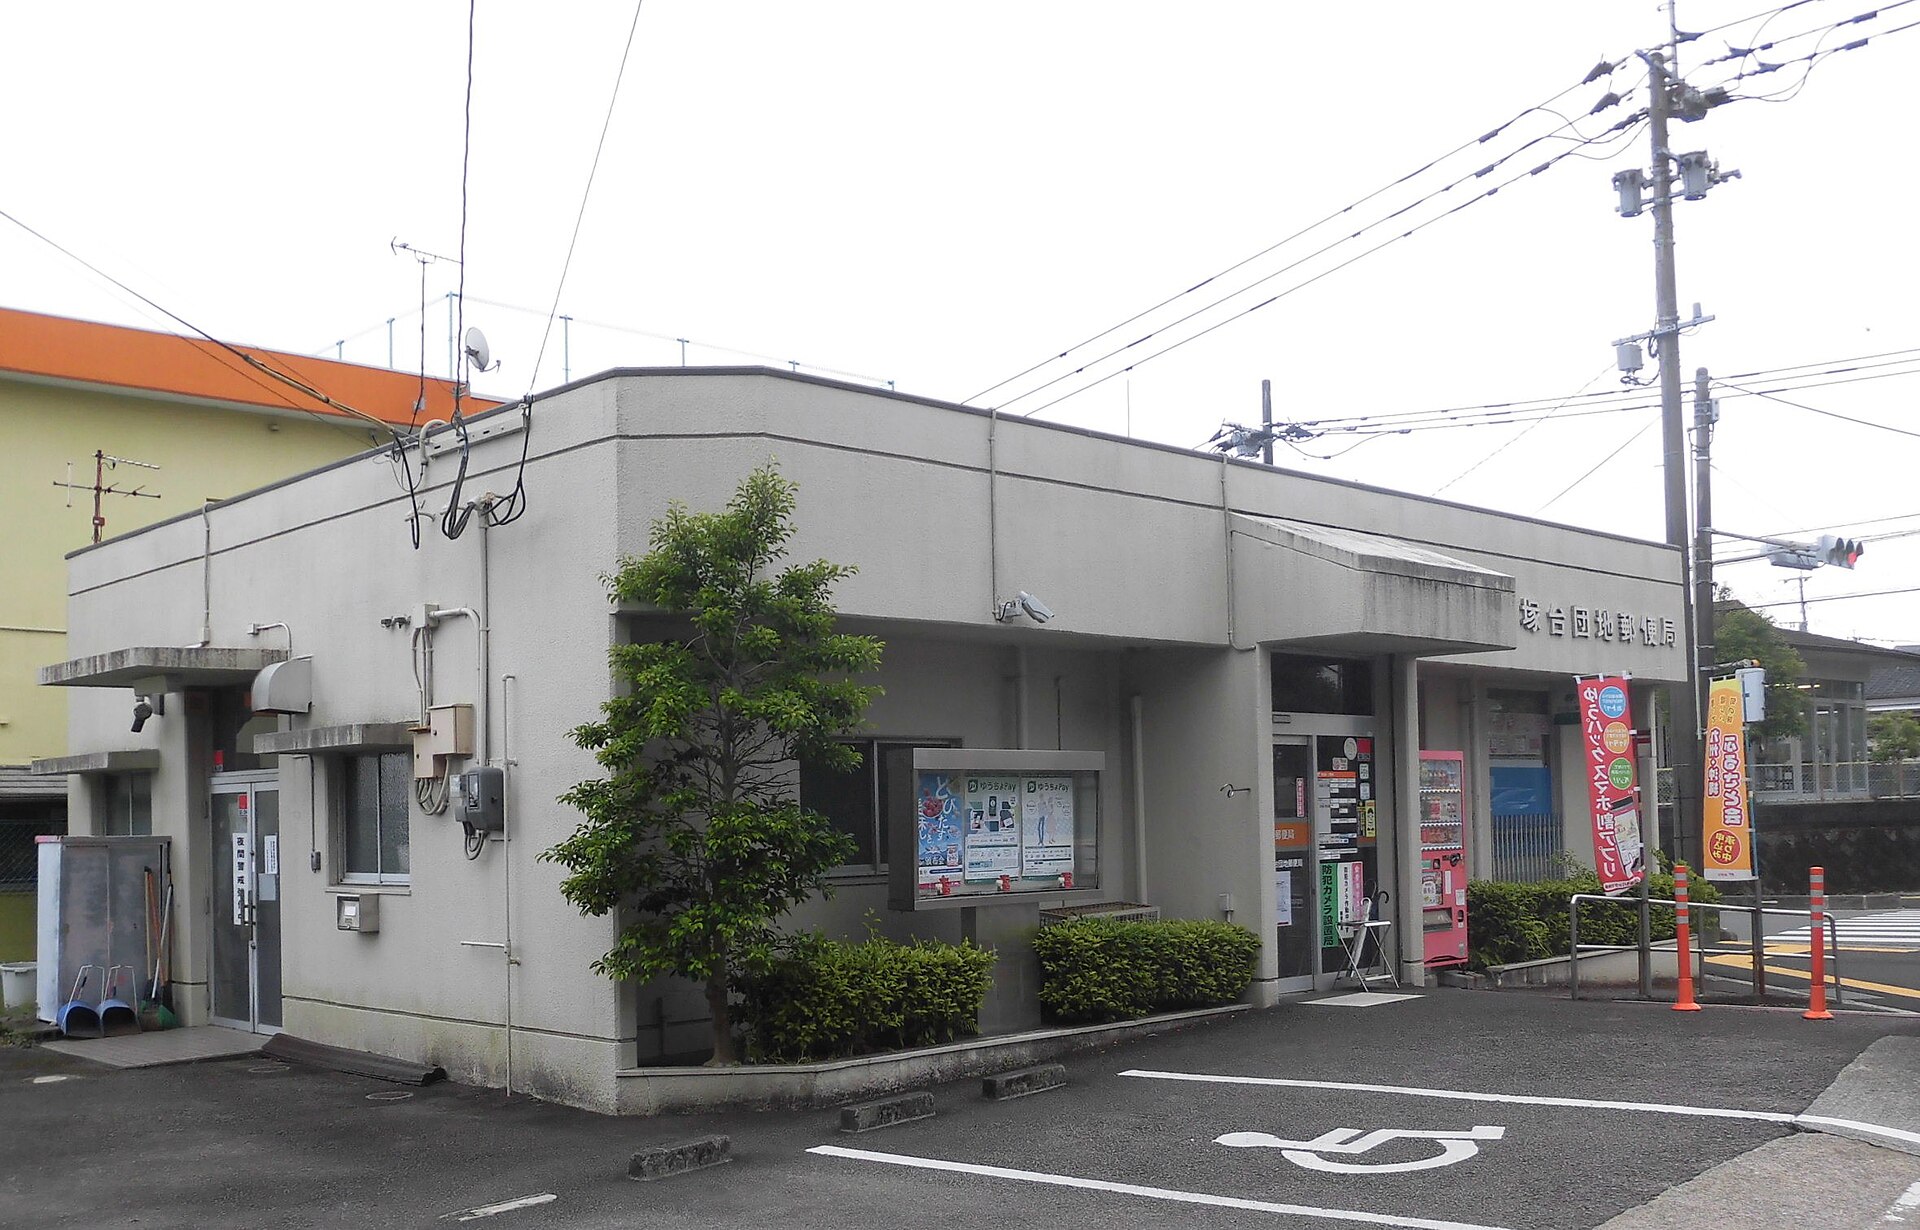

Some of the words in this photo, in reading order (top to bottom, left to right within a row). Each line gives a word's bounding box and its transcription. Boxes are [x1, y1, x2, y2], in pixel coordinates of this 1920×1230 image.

[1519, 597, 1677, 648] 塚台団地郵便局
